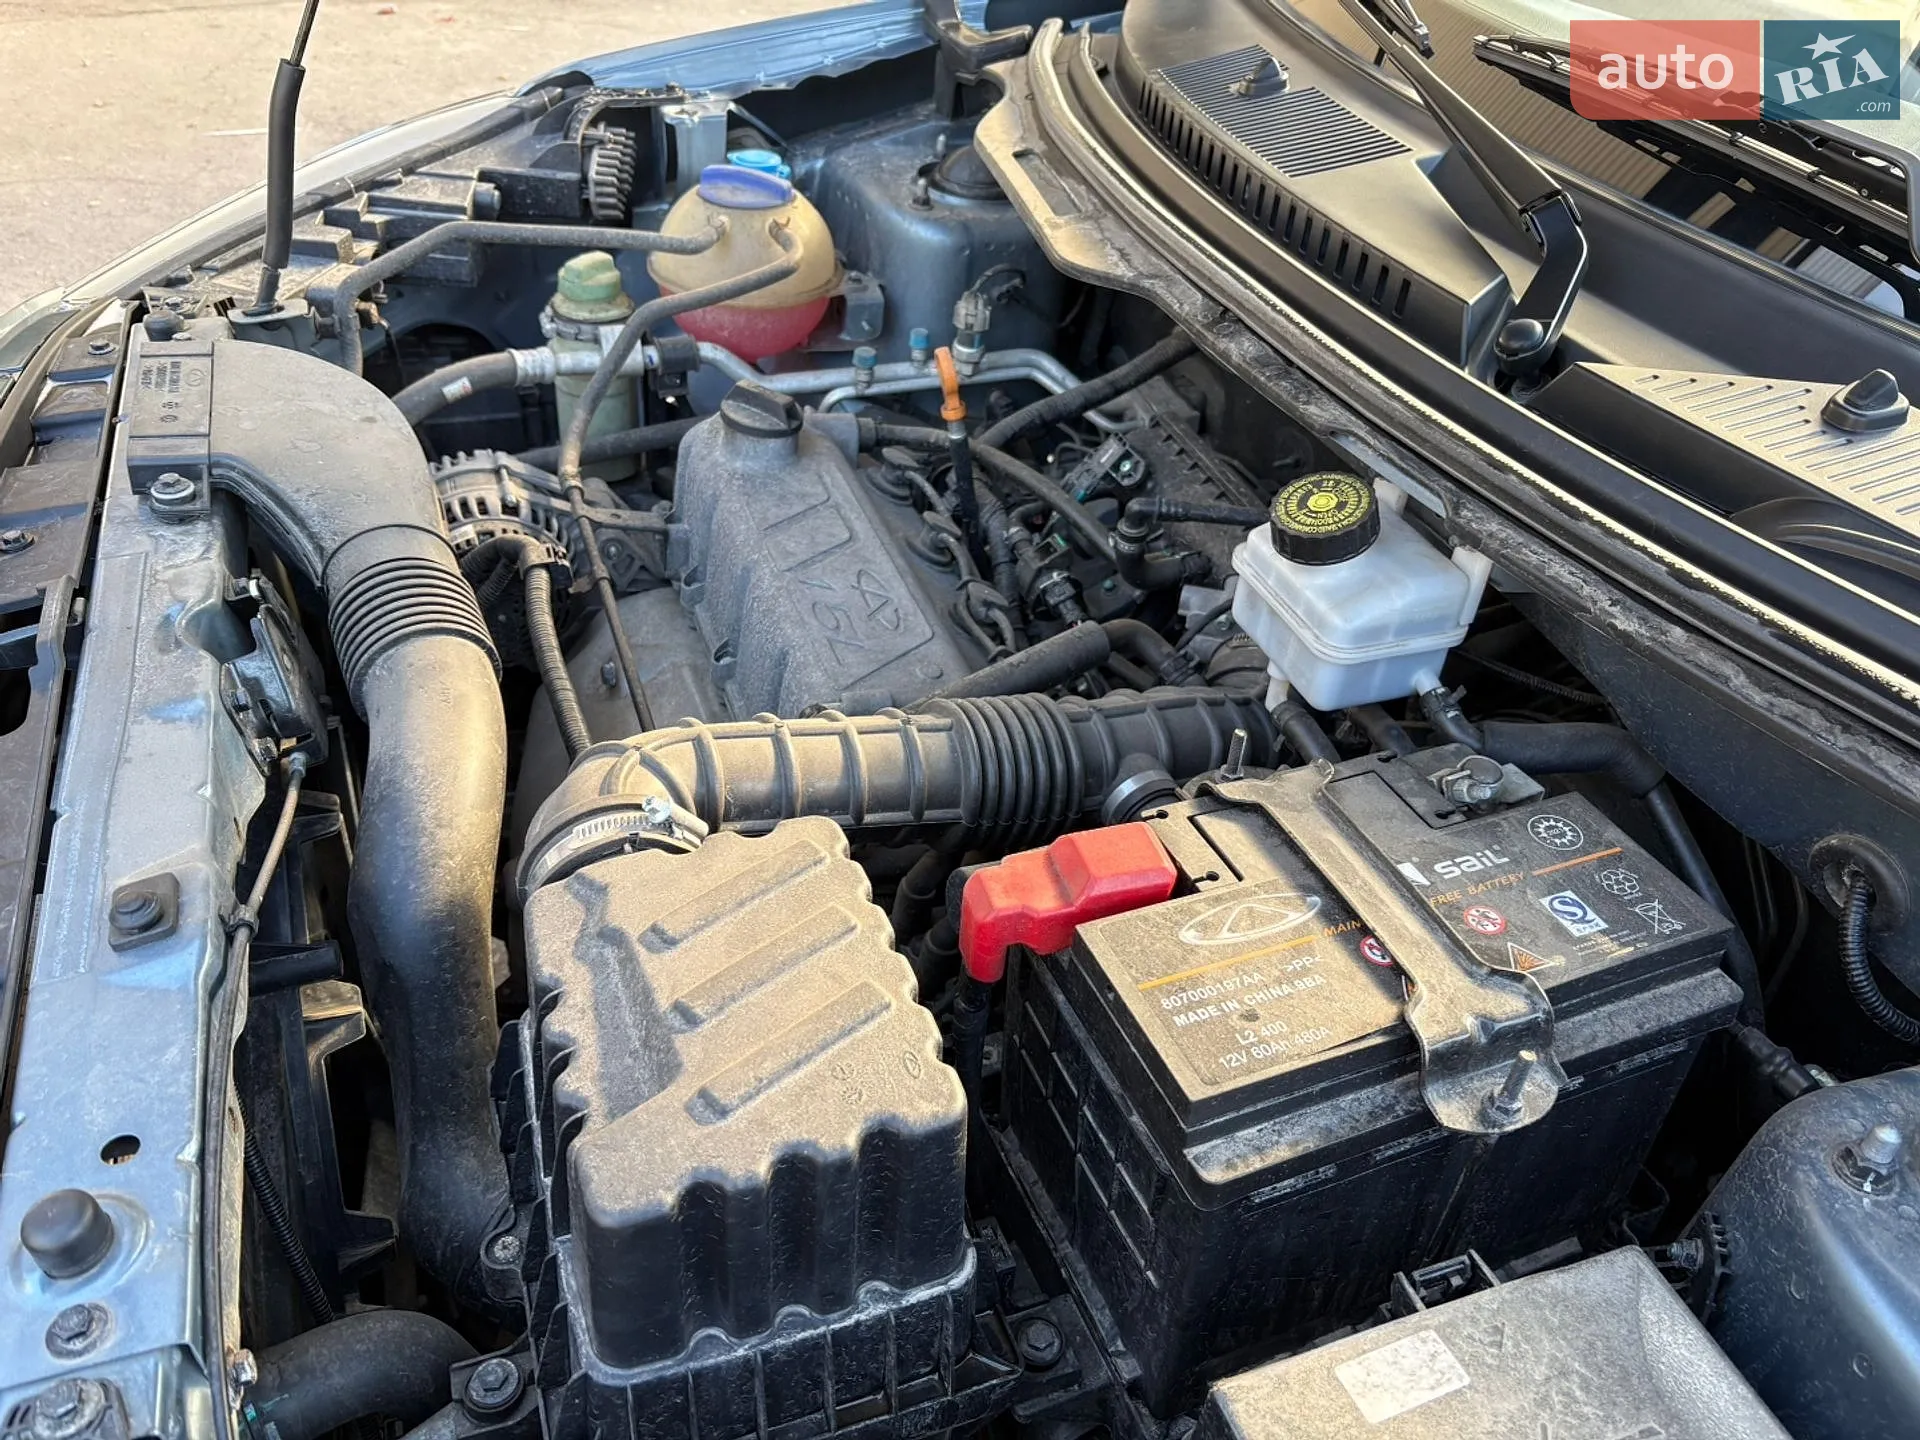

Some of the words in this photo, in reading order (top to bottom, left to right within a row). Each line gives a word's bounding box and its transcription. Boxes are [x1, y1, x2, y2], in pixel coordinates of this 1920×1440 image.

[1430, 889, 1463, 906] FREE
[1467, 871, 1524, 896] BATTERY
[1160, 972, 1265, 1010] 807000197AA
[1172, 1004, 1222, 1028] MADE
[1221, 998, 1241, 1013] IN
[1243, 983, 1296, 1006] CHINA
[1219, 1050, 1248, 1069] 12V
[1250, 1039, 1293, 1059] 60Ah
[1294, 1026, 1333, 1045] 480A
[1235, 1030, 1259, 1046] L2
[1261, 1020, 1289, 1037] 400
